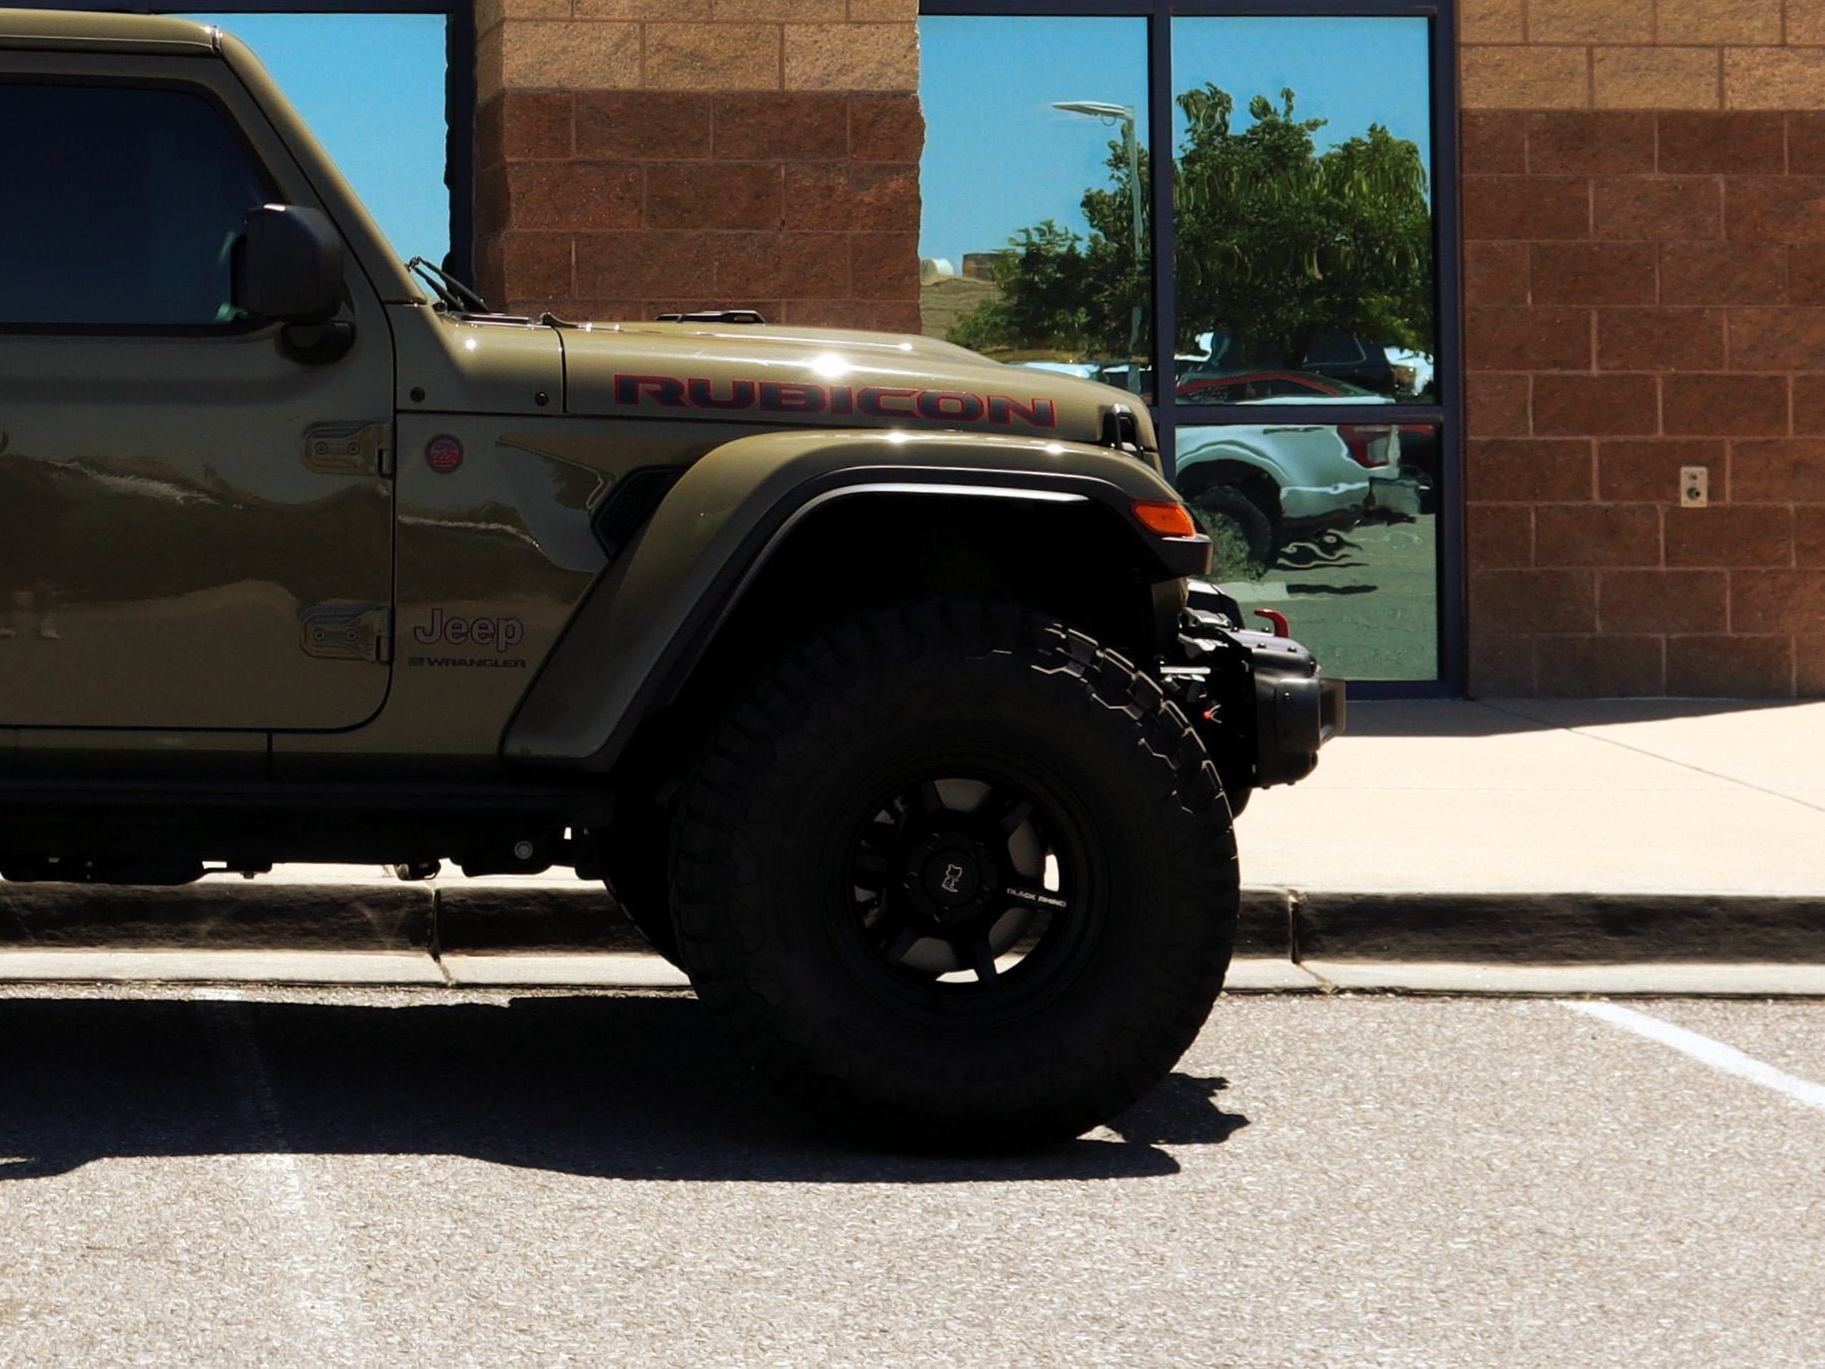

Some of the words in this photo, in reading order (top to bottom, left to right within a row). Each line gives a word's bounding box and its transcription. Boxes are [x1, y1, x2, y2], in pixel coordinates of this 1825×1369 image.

[614, 374, 1056, 428] RUBICON
[414, 608, 523, 652] Jeep
[426, 657, 527, 668] WRANGLER
